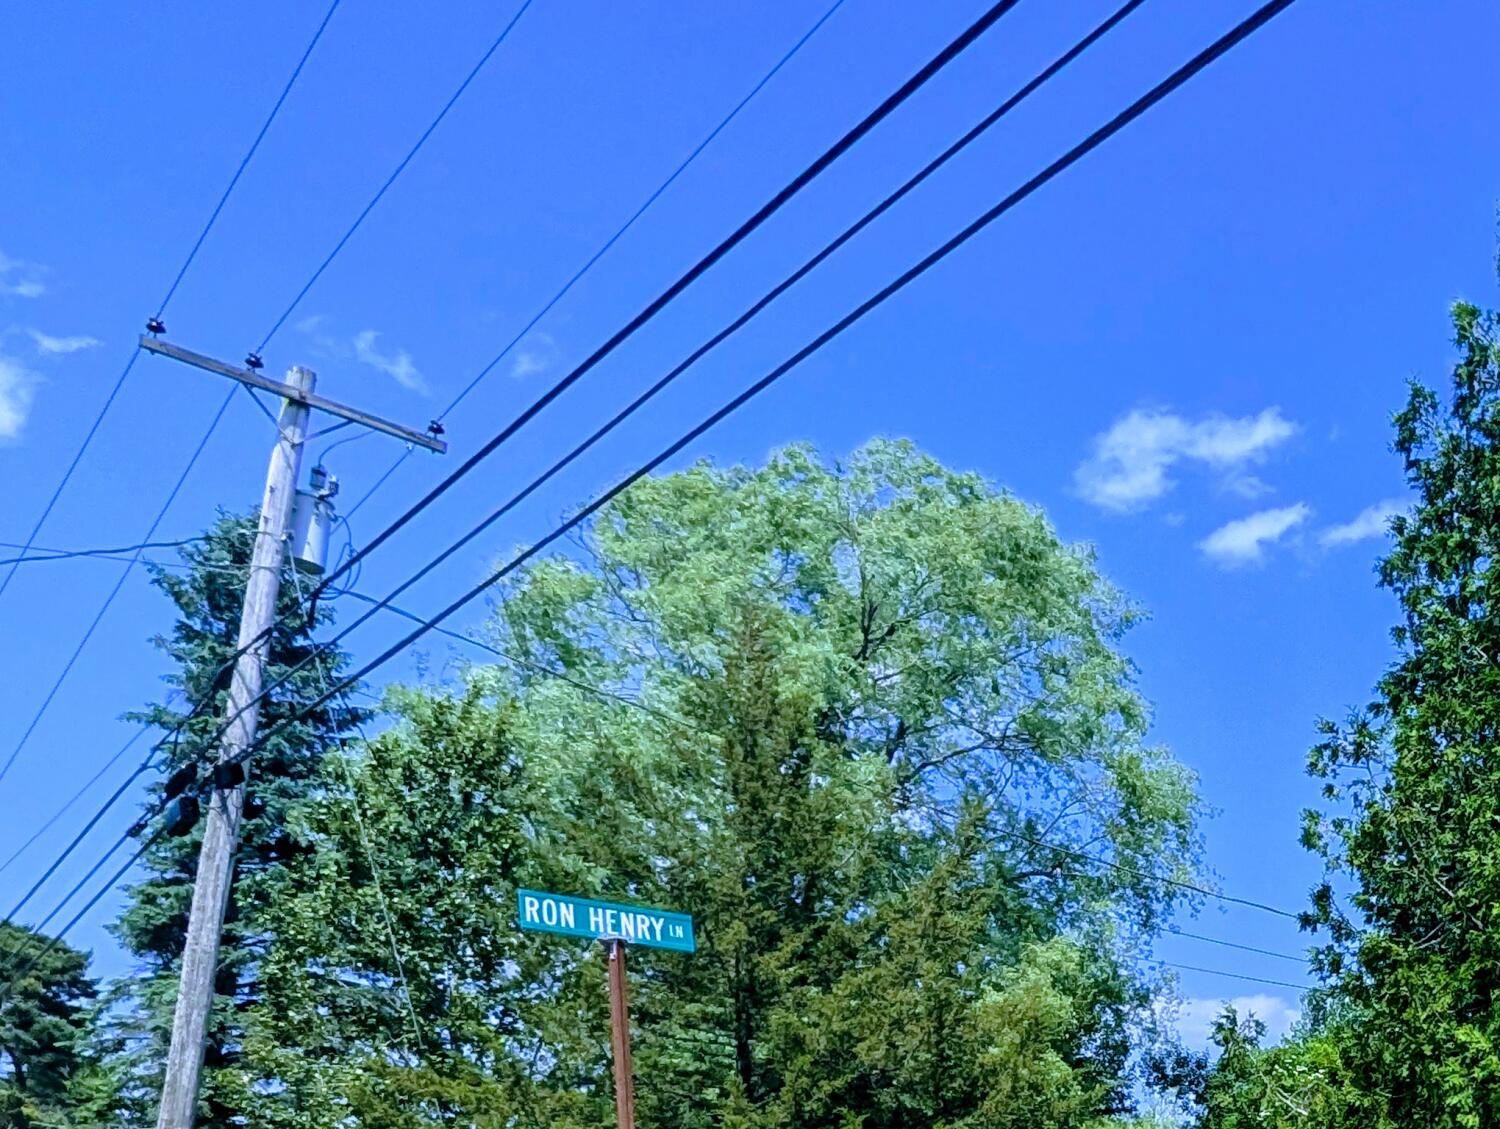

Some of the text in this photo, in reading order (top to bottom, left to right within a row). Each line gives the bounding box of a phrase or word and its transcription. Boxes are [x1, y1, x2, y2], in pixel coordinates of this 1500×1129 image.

[524, 896, 684, 942] RON HENRY LN
